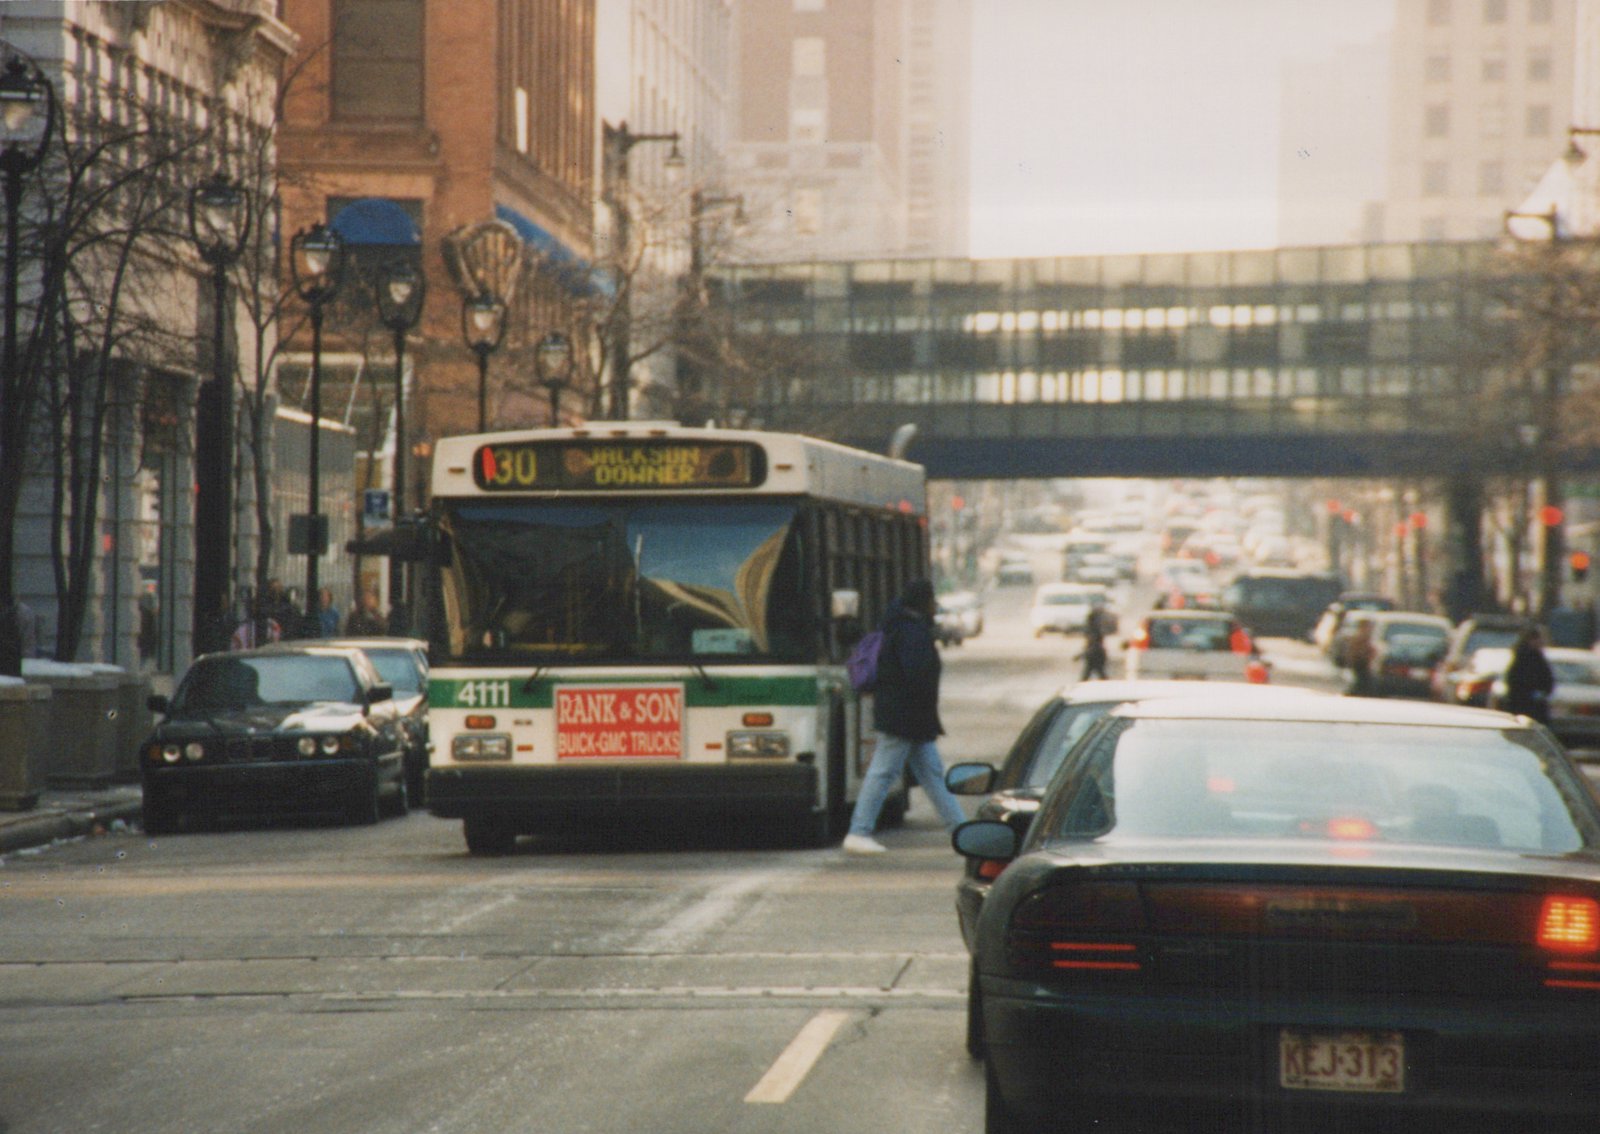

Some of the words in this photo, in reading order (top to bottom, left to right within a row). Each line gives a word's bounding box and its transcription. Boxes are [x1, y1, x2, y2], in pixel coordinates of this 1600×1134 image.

[493, 448, 537, 485] 30
[594, 464, 695, 485] DOWNER
[459, 681, 510, 707] 4111
[559, 694, 617, 723] RANK
[620, 701, 631, 720] &
[635, 693, 681, 724] SON
[630, 731, 681, 753] TRUCKS
